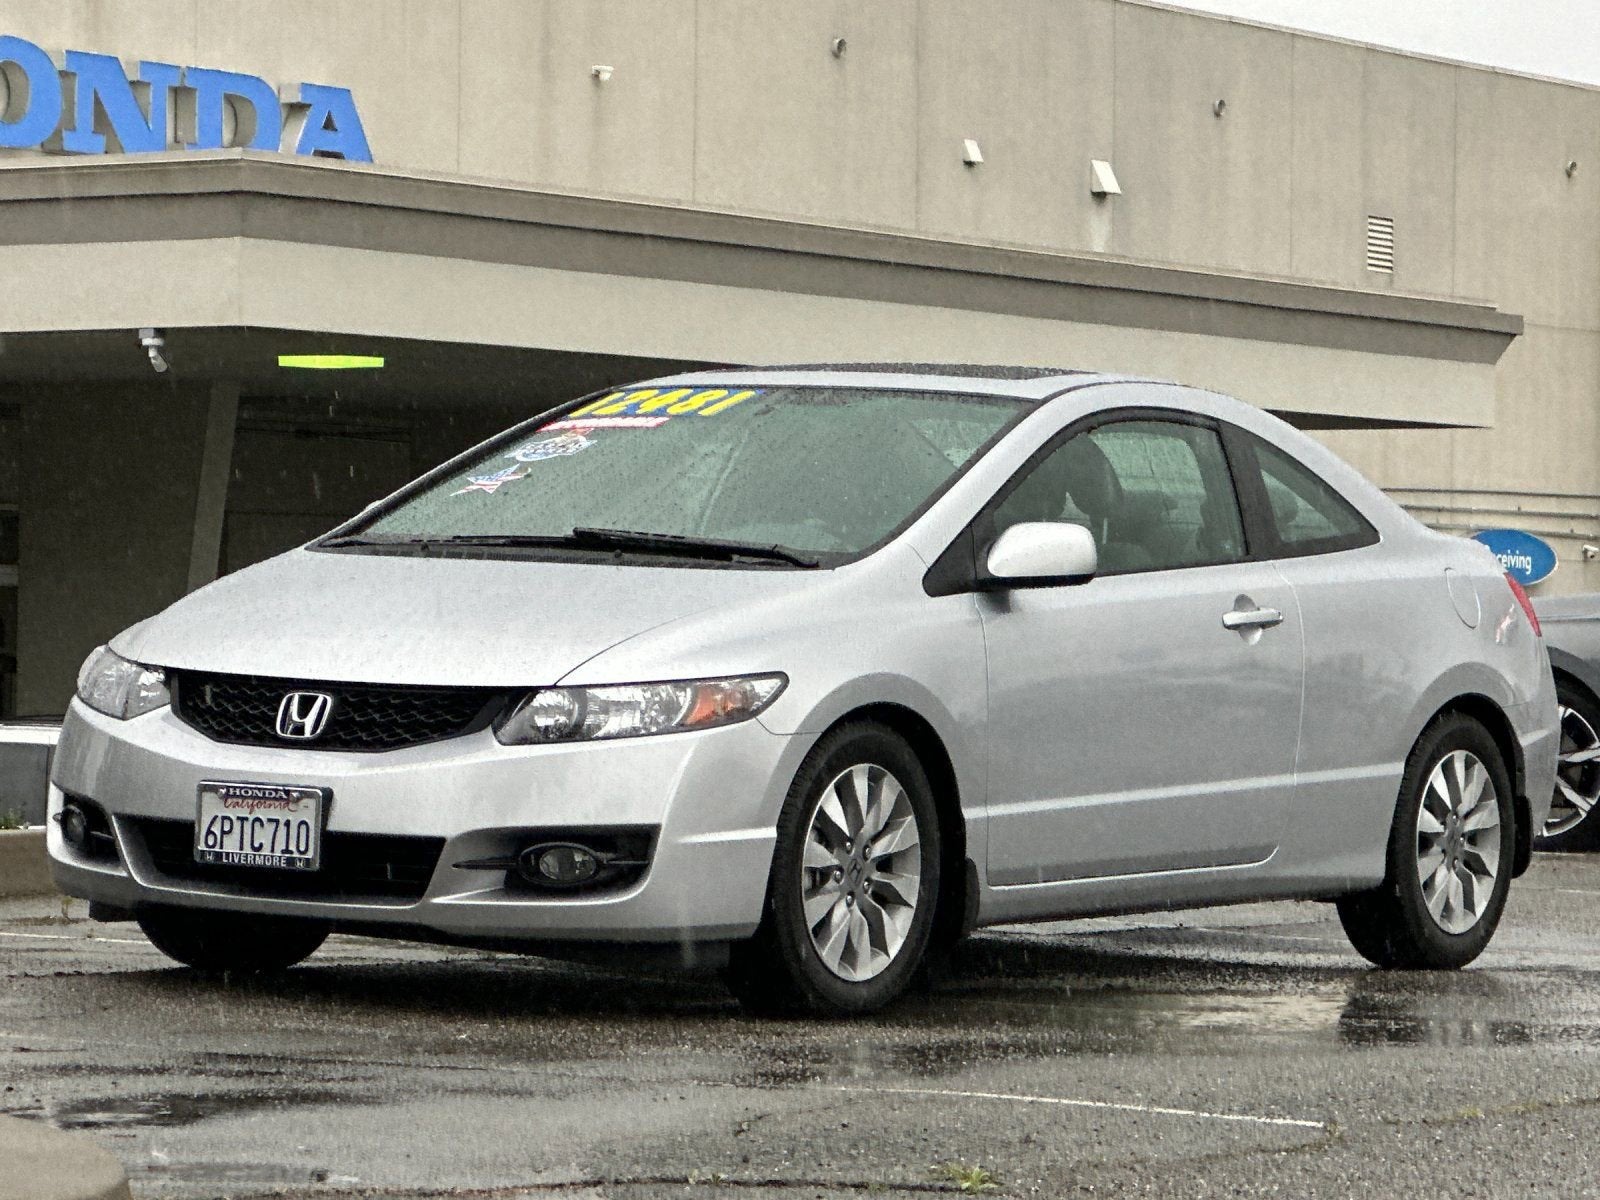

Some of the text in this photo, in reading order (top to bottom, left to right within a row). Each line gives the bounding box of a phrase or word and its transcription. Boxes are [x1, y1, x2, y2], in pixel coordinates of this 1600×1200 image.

[569, 389, 756, 416] 12481
[228, 788, 288, 799] HONDA
[224, 798, 298, 814] California
[204, 815, 309, 855] 6PTC710
[222, 852, 287, 867] LIVERMORE
